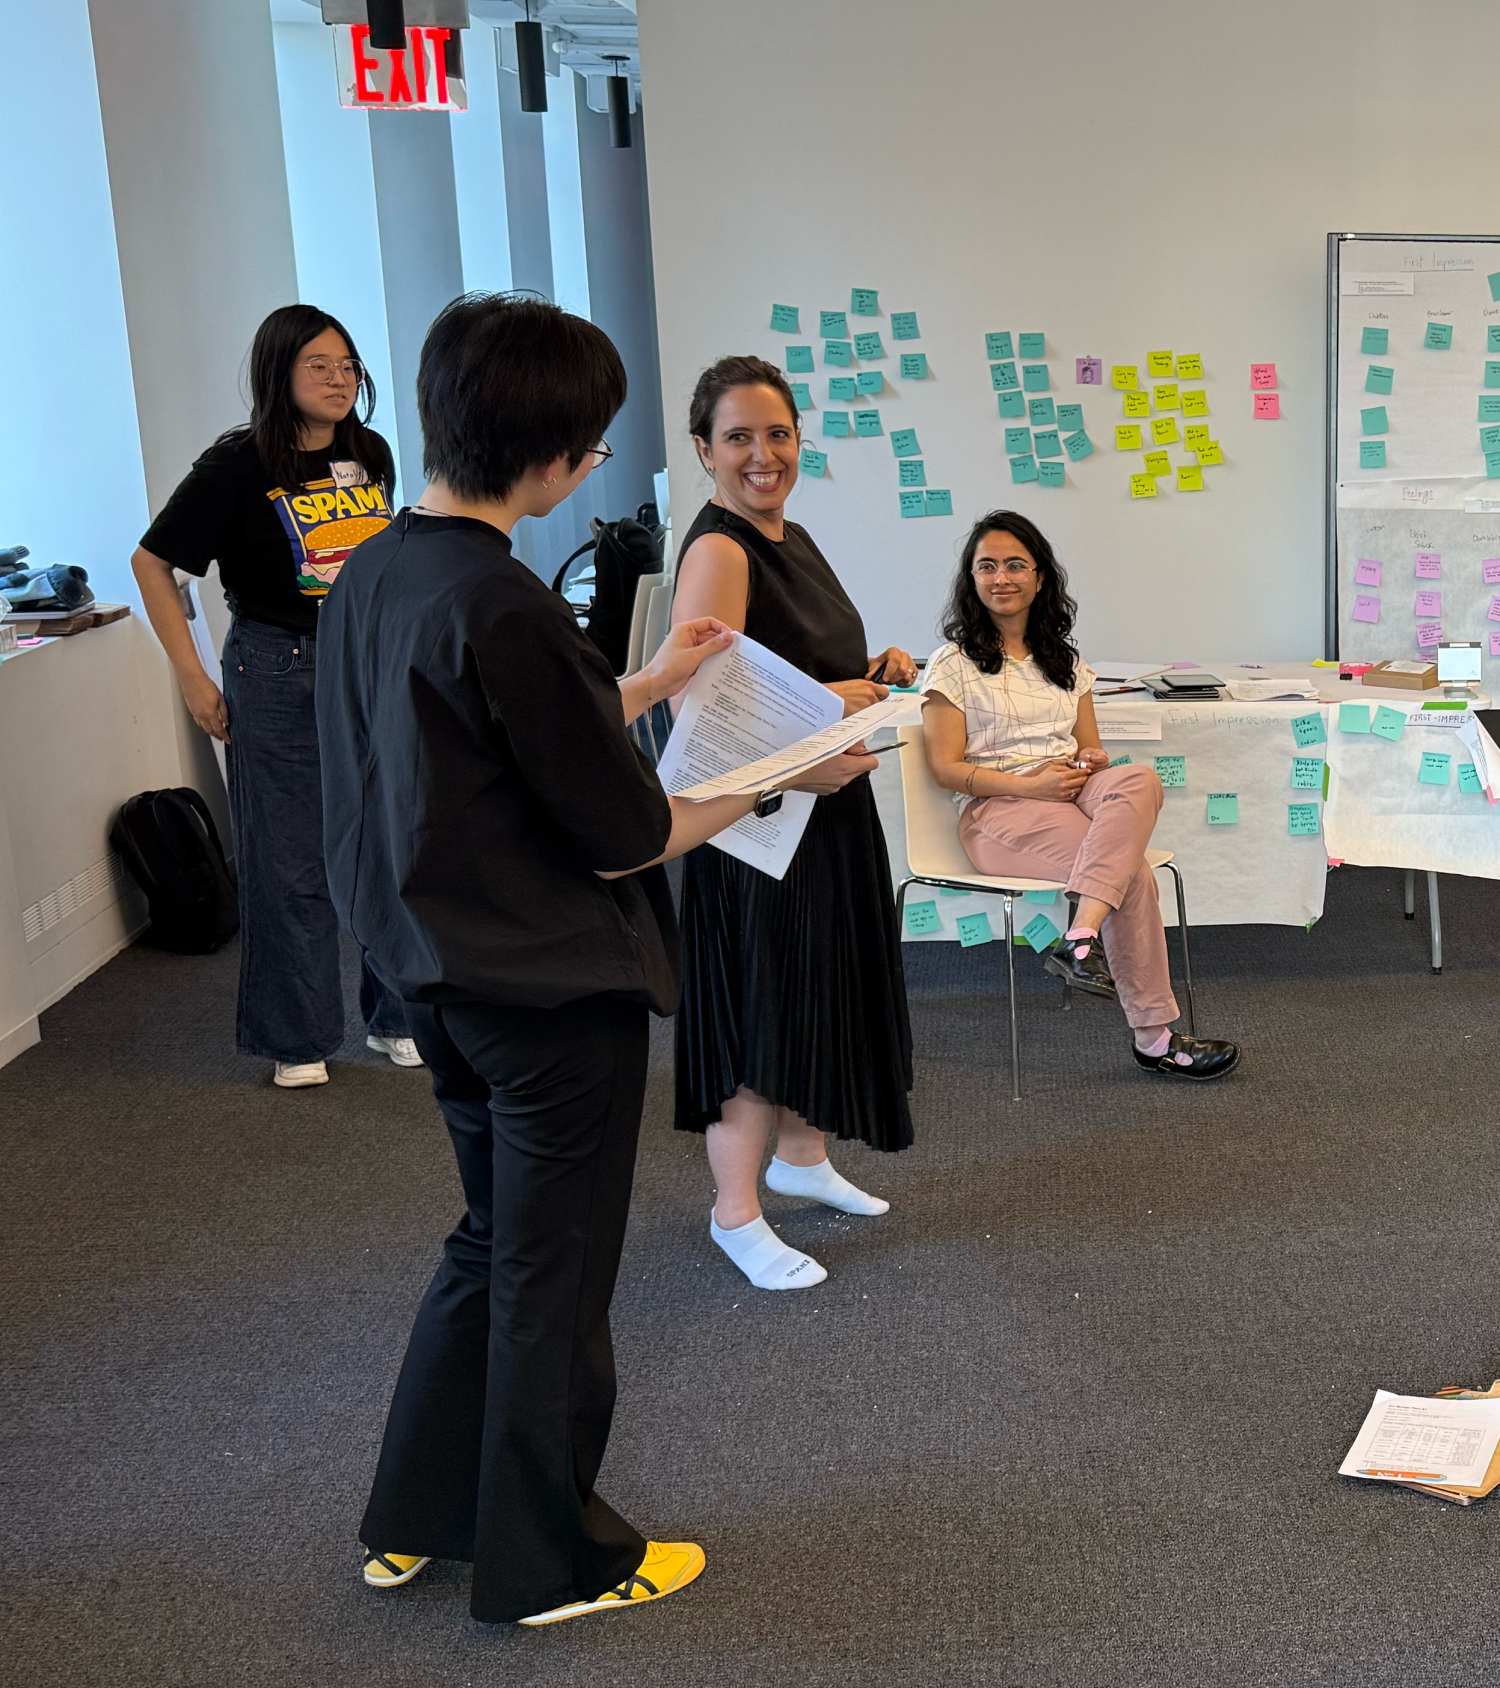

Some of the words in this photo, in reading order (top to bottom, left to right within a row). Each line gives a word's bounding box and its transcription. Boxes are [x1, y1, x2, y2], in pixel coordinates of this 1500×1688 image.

[350, 25, 451, 104] EXIT
[292, 486, 387, 524] SPAM
[1402, 487, 1434, 504] Feelings
[1168, 709, 1199, 725] First
[1212, 711, 1280, 731] Impression
